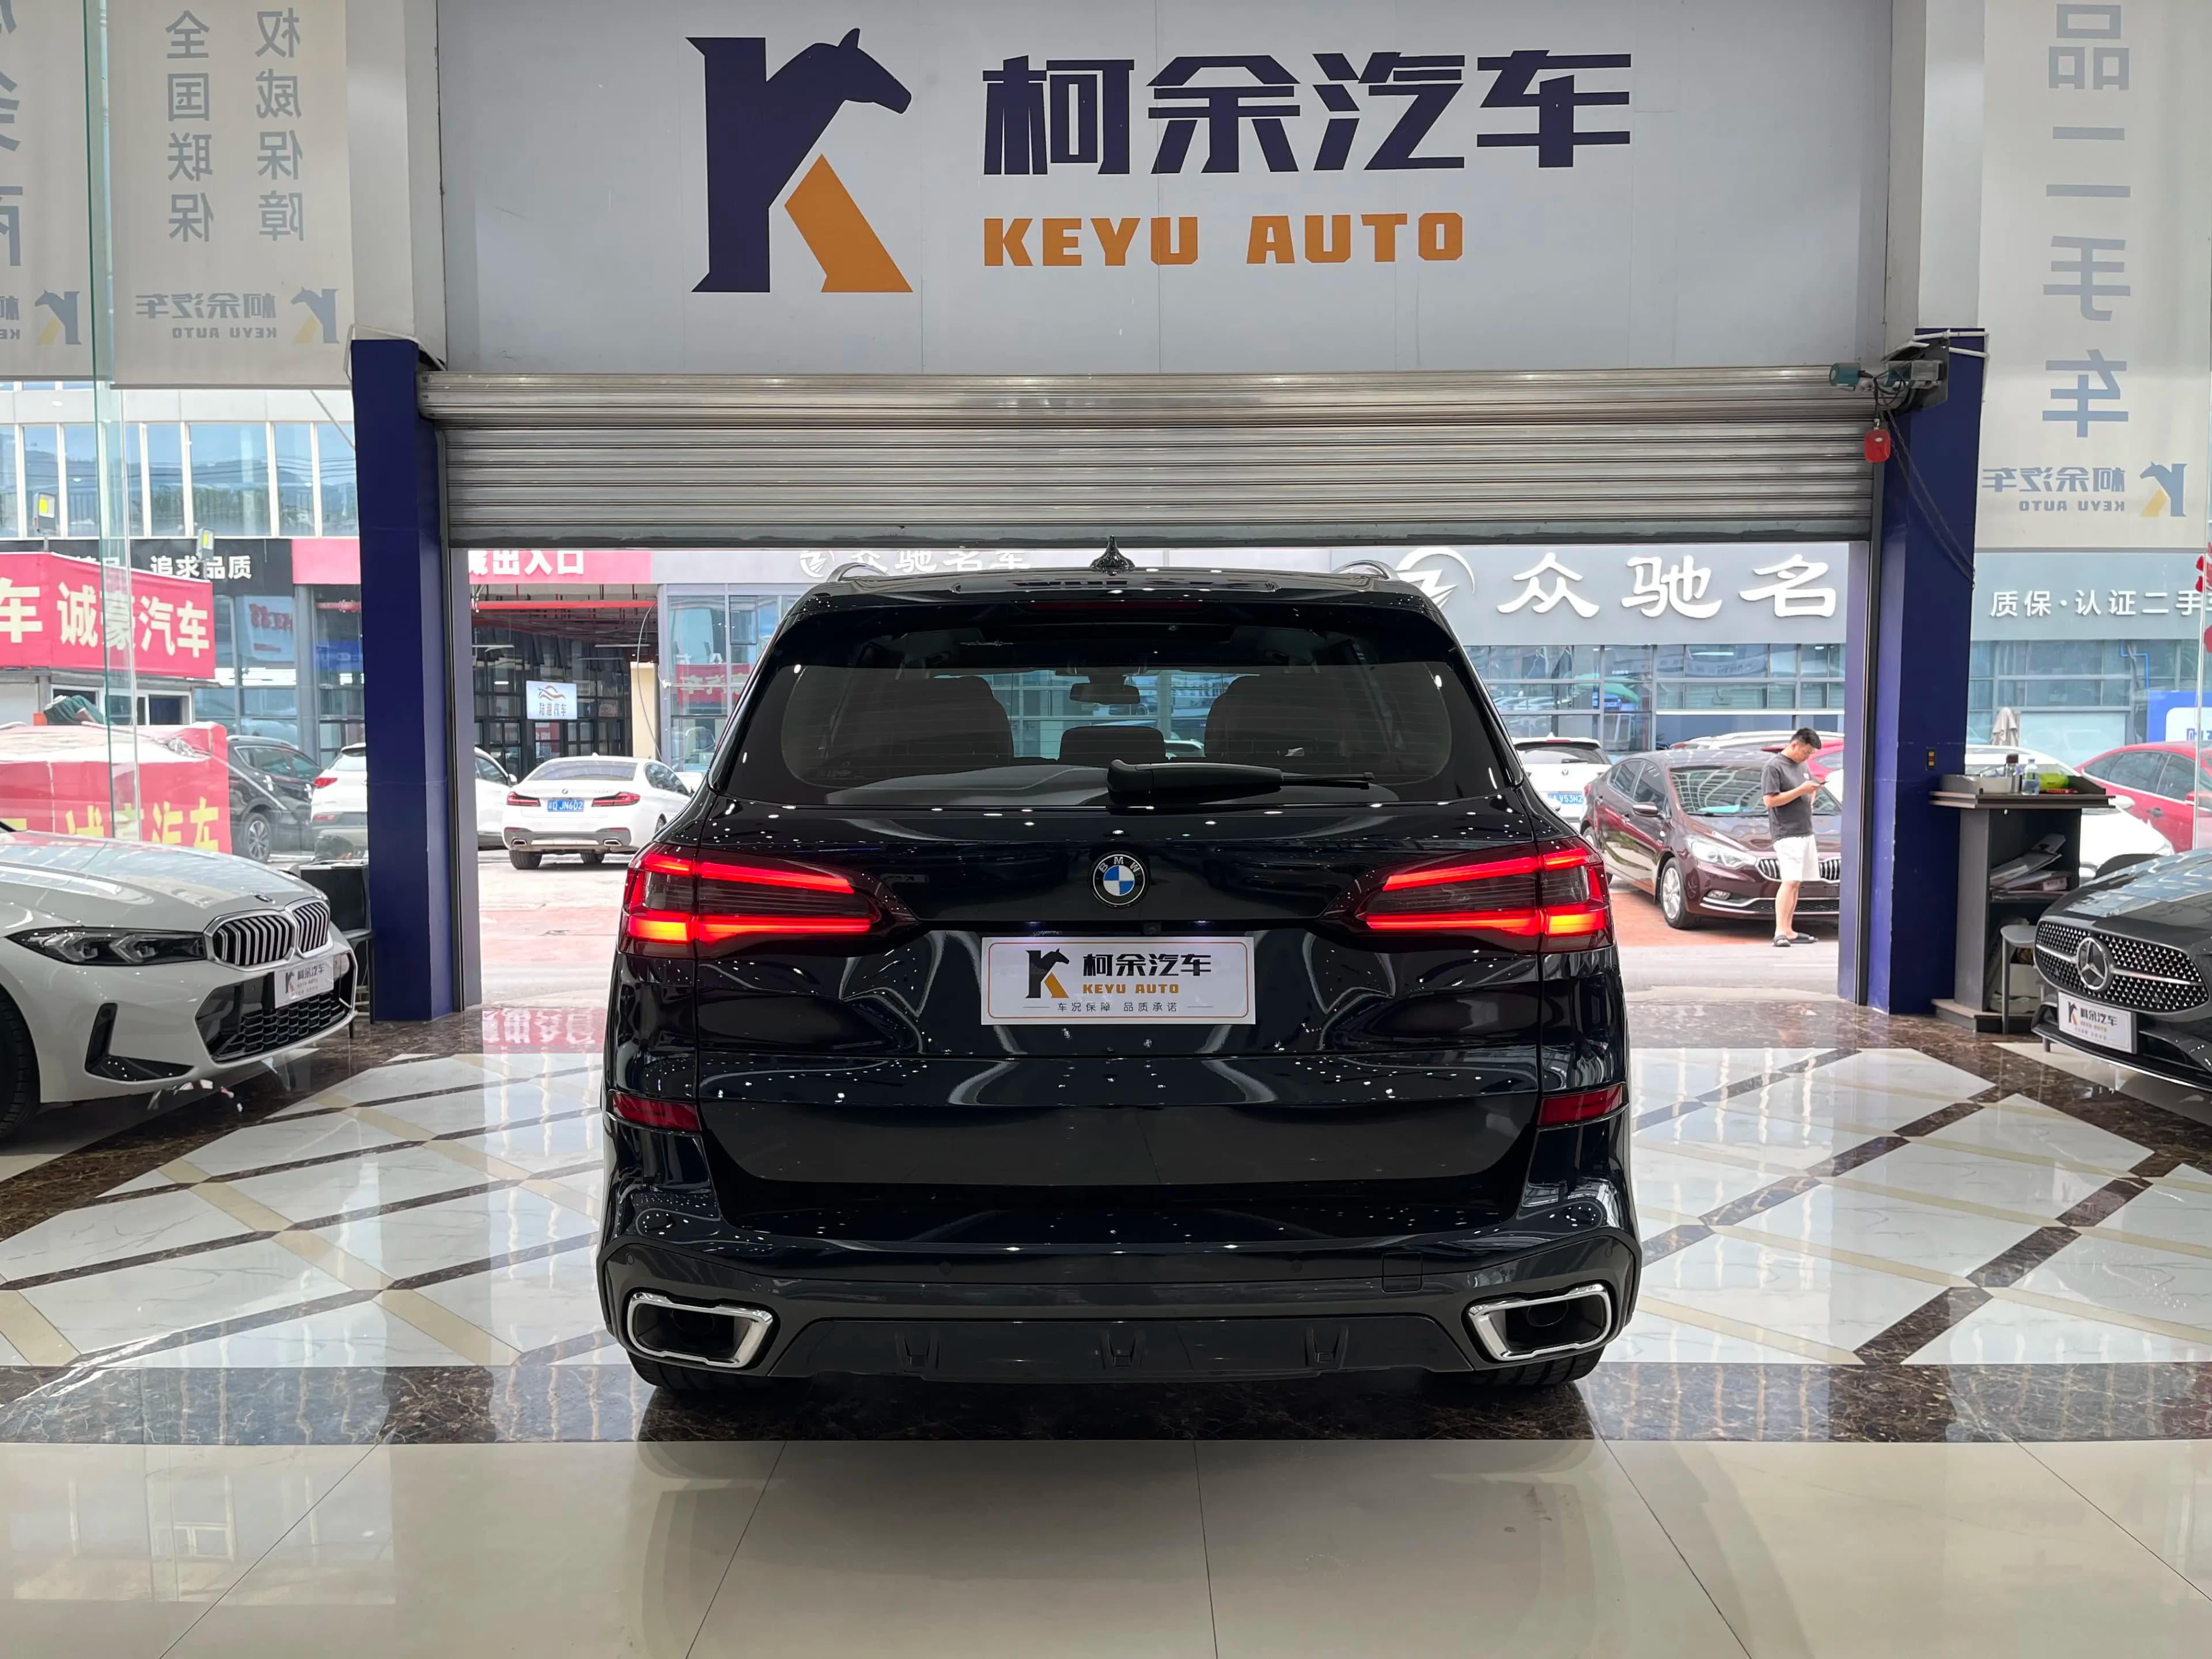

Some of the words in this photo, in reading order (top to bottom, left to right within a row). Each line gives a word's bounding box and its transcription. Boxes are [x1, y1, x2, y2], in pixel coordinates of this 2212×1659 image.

[983, 50, 1631, 175] 柯余汽车
[984, 217, 1199, 267] KEYU
[1247, 213, 1464, 264] AUTO
[150, 555, 252, 579] 追求品质
[1498, 551, 1836, 619] 众驰名
[57, 581, 210, 658] 诚豪汽车
[1099, 857, 1140, 873] BMW
[1083, 953, 1211, 976] 柯余汽车
[1083, 983, 1126, 994] KEYU
[1135, 983, 1179, 994] AUTO
[1058, 1002, 1111, 1012] 车况保障
[1123, 1002, 1177, 1012] 品质承诺
